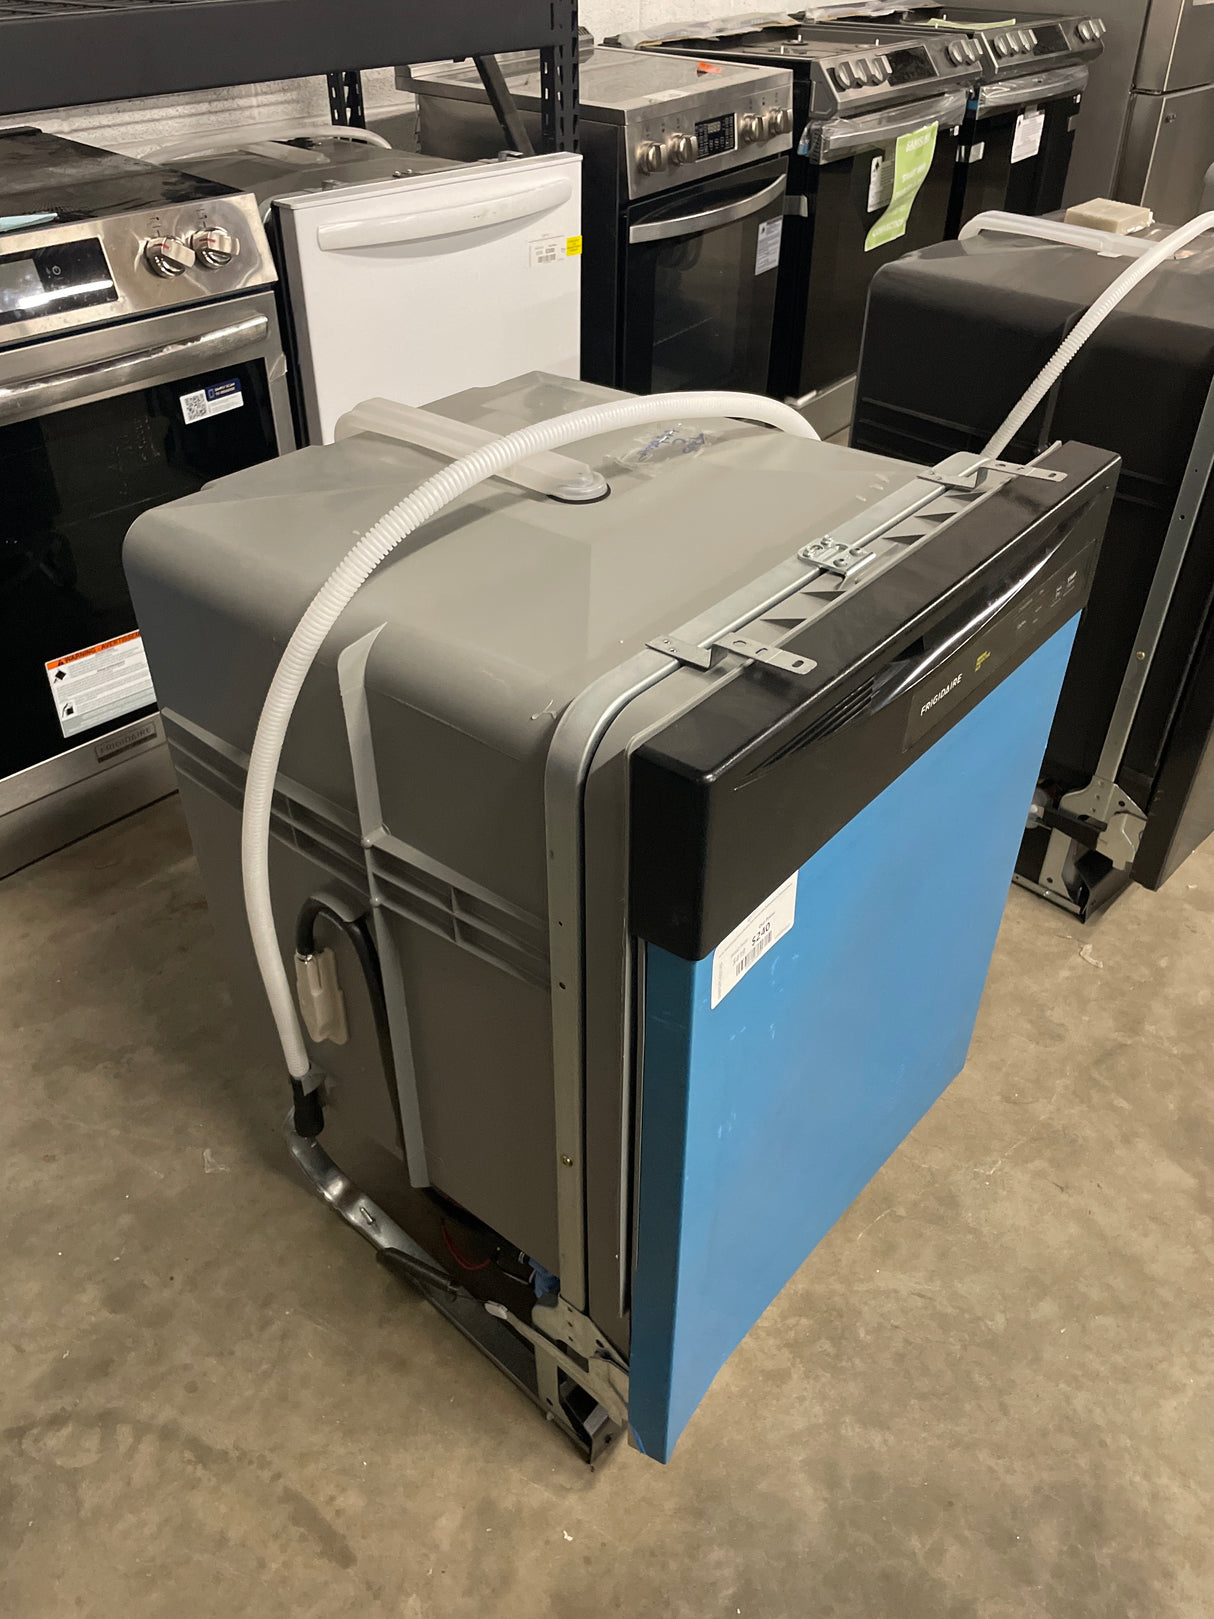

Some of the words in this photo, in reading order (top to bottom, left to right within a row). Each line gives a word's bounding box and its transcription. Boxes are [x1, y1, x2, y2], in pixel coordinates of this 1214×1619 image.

[65, 647, 97, 663] WARNING
[920, 673, 963, 716] FRIGIDAIRE
[100, 727, 152, 754] FRIGIDAIRE
